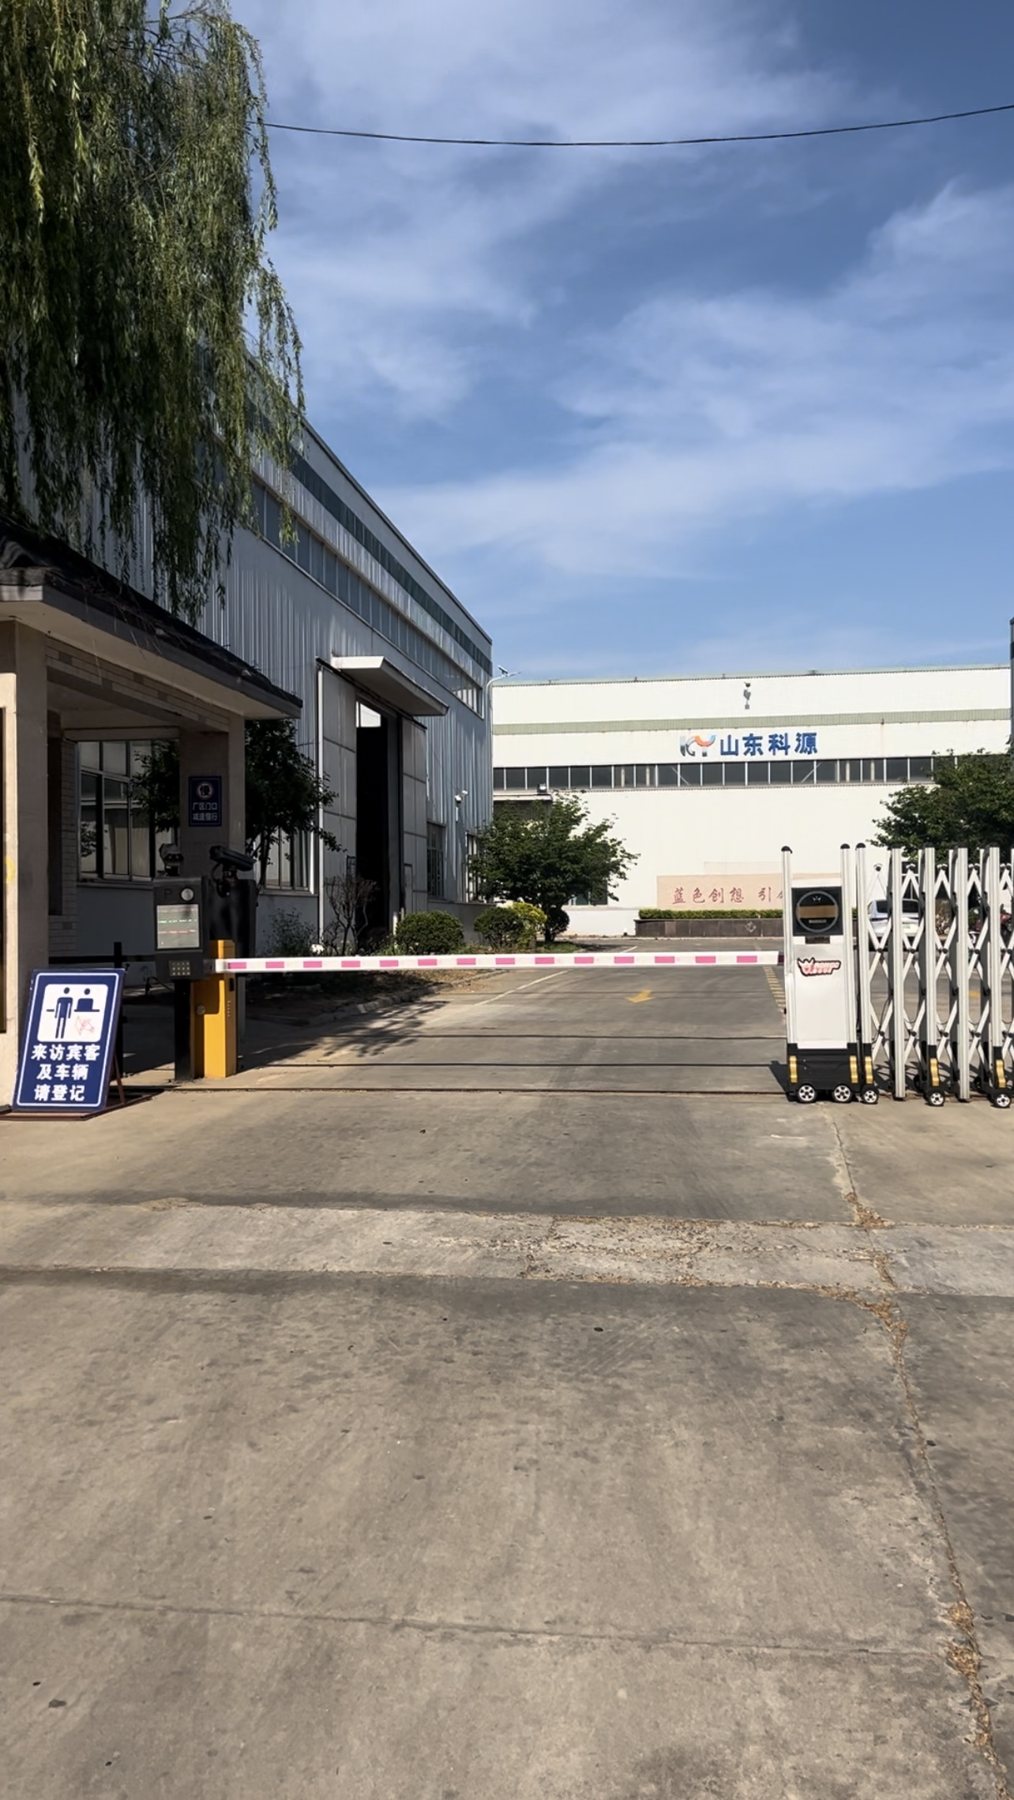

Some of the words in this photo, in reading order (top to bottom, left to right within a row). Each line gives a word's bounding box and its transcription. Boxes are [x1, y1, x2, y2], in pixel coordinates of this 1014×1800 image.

[720, 732, 818, 756] 山东科源
[672, 887, 744, 904] 蓝色创想
[31, 1043, 100, 1061] 来访宾客
[36, 1063, 89, 1081] 及车辆
[33, 1084, 85, 1102] 请登记
